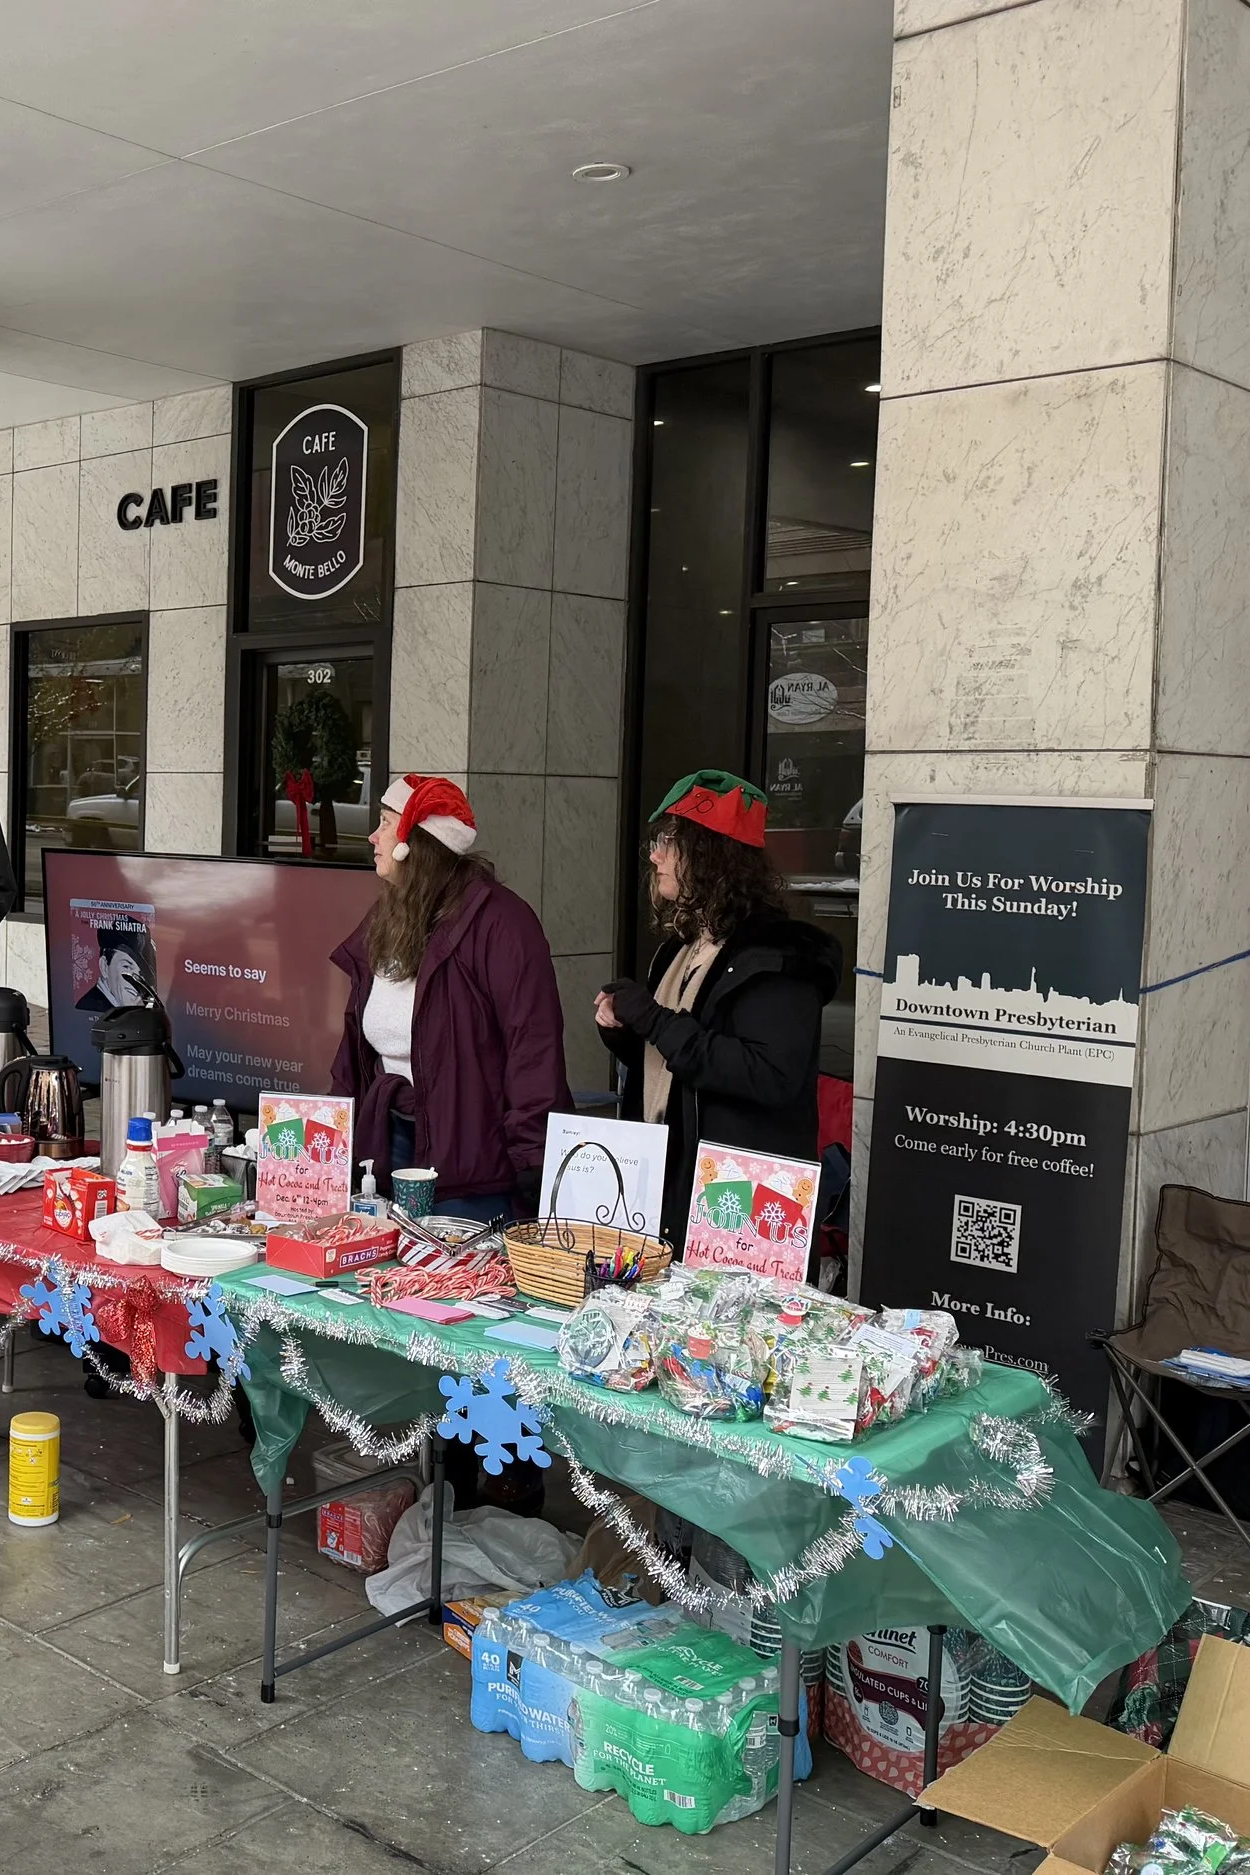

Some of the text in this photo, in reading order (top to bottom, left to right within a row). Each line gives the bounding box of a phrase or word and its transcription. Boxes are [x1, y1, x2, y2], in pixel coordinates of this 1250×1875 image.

[302, 431, 337, 455] CAFE
[116, 478, 218, 531] CAFE
[282, 549, 347, 579] MONTE BELLO
[306, 668, 332, 684] 302
[907, 869, 1124, 901] Join Us For Worship
[80, 910, 95, 919] JOLLY
[95, 911, 129, 922] CHRISTMAS
[942, 893, 1078, 921] This Sunday!
[89, 919, 148, 934] FRANK SINATRA
[184, 959, 267, 984] Seems to say
[185, 1002, 291, 1028] Merry Christmas
[895, 999, 1118, 1035] Downtown Presbyterian
[893, 1026, 1116, 1063] An Evangelical Presbyterian Church Plant (EPC)
[186, 1043, 304, 1074] May your new year
[187, 1065, 300, 1093] dreams come true
[905, 1105, 1087, 1148] Worship: 4:30pm
[259, 1142, 350, 1167] JOIN US
[580, 1151, 591, 1160] do
[592, 1154, 608, 1163] you
[616, 1156, 639, 1166] lieve
[894, 1134, 1095, 1179] Come early for free coffee!
[295, 1163, 309, 1175] for
[566, 1164, 595, 1174] sus is?
[258, 1172, 349, 1193] Hot Cocoa and Treats
[303, 1195, 329, 1207] 12-4pm
[690, 1202, 809, 1249] JOIN US
[735, 1237, 755, 1252] for
[686, 1239, 804, 1283] Hot Cocoa and Treats
[930, 1290, 1032, 1327] More Info:
[520, 1603, 542, 1613] 40
[481, 1651, 500, 1666] 40
[867, 1645, 909, 1669] COMFORT
[887, 1686, 910, 1703] CUPS
[529, 1707, 570, 1733] WATER
[593, 1749, 613, 1761] FOR
[630, 1769, 667, 1786] PLANET
[603, 1741, 655, 1776] RECYCLE
